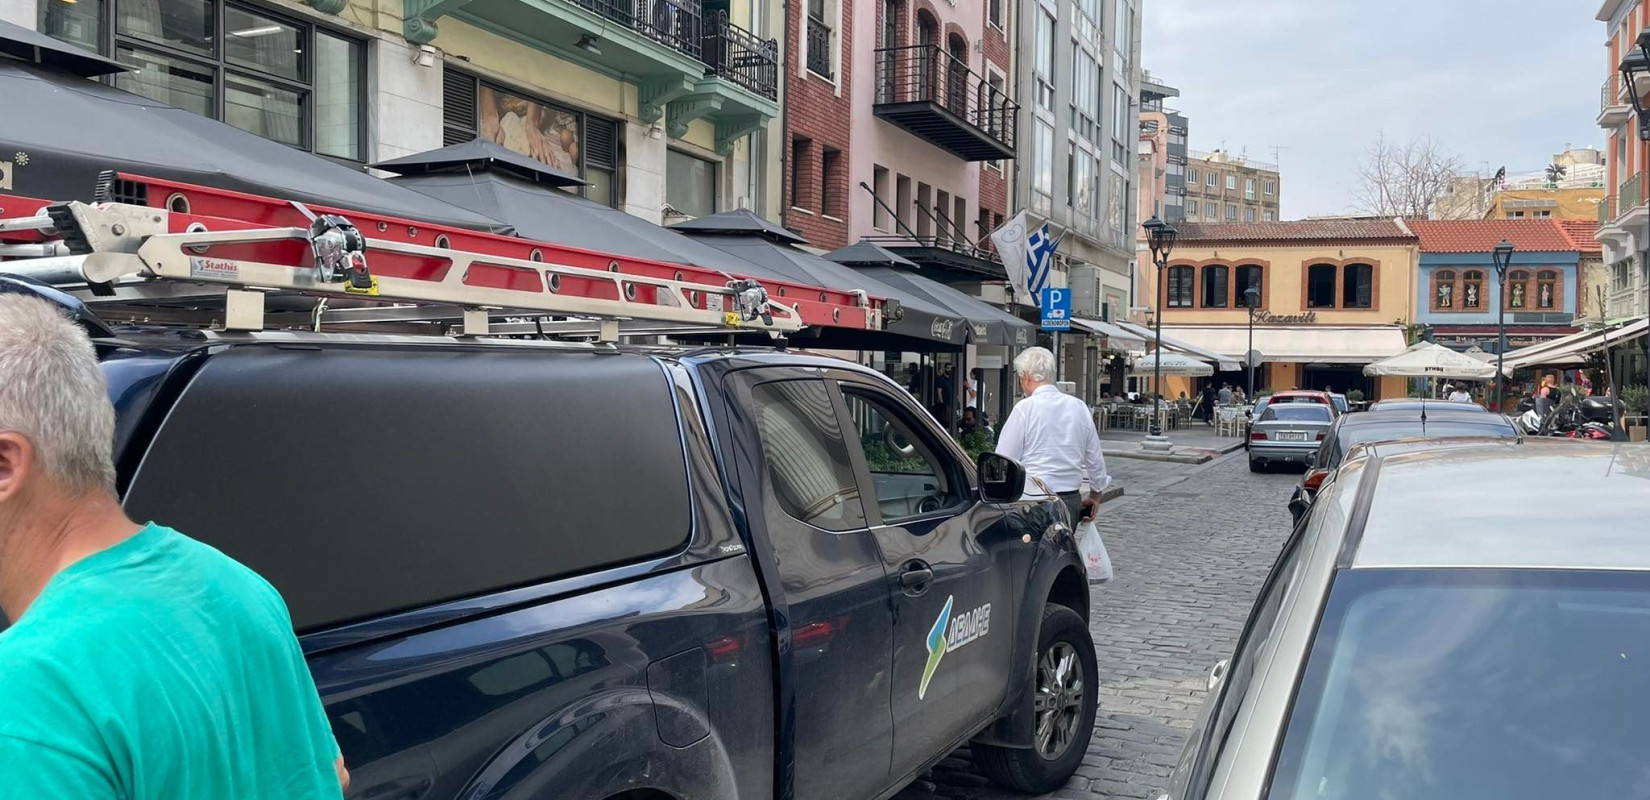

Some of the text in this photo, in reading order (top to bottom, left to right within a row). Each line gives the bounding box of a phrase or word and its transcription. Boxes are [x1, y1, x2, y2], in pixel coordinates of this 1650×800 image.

[205, 260, 238, 271] Stathis
[1050, 290, 1062, 310] P
[1252, 310, 1316, 323] Kazaviti
[947, 603, 991, 652] ΔΕΔΔΗΕ
